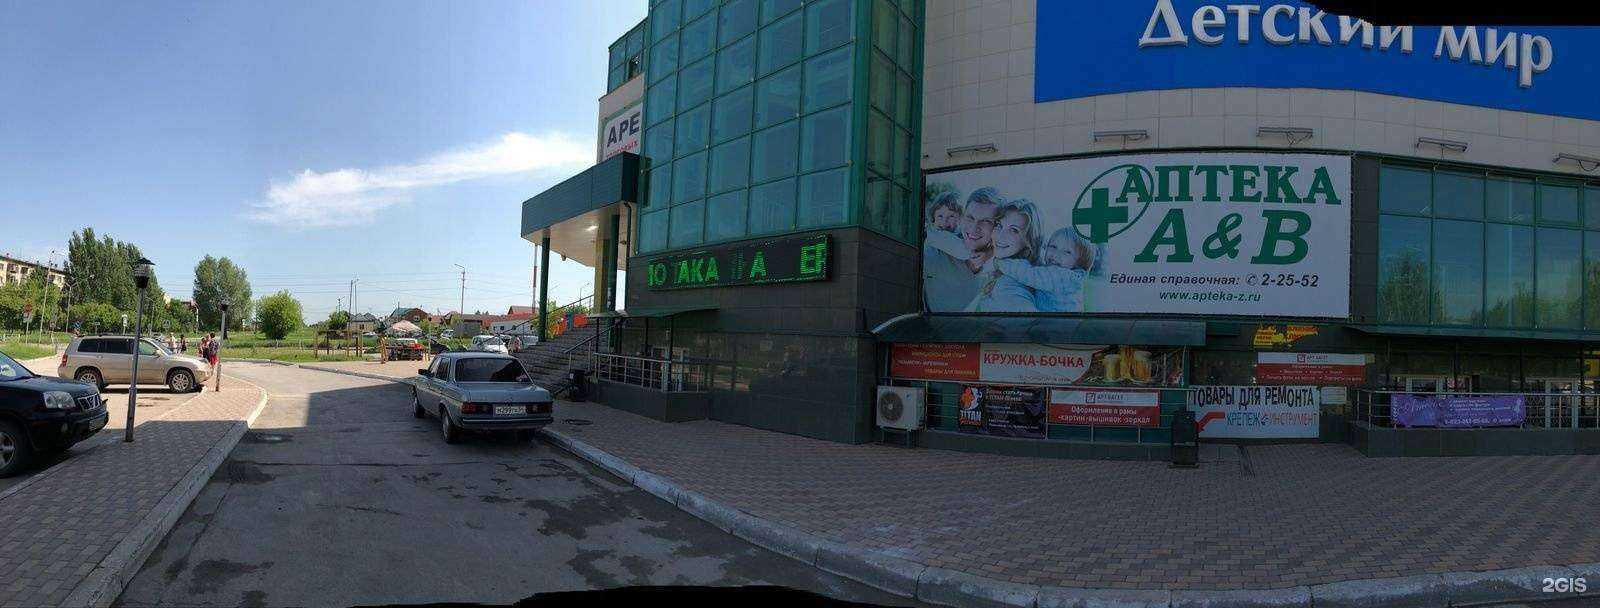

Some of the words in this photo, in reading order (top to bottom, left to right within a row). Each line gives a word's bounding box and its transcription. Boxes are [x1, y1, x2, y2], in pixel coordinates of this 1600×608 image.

[1433, 25, 1553, 89] мир
[1115, 164, 1342, 205] АПТЕКА
[1110, 273, 1156, 286] Единая
[1160, 274, 1240, 287] справочная:
[1261, 273, 1319, 288] 2-25-52
[1159, 291, 1262, 303] www.apteka-z.ru
[983, 353, 1085, 368] КРУЖКА-БОЧКА
[1191, 387, 1235, 407] ТОВАРЫ
[1239, 387, 1261, 410] ДЛЯ
[1265, 386, 1315, 408] РЕМОНТА
[1226, 412, 1261, 427] КРЕПЕЖ
